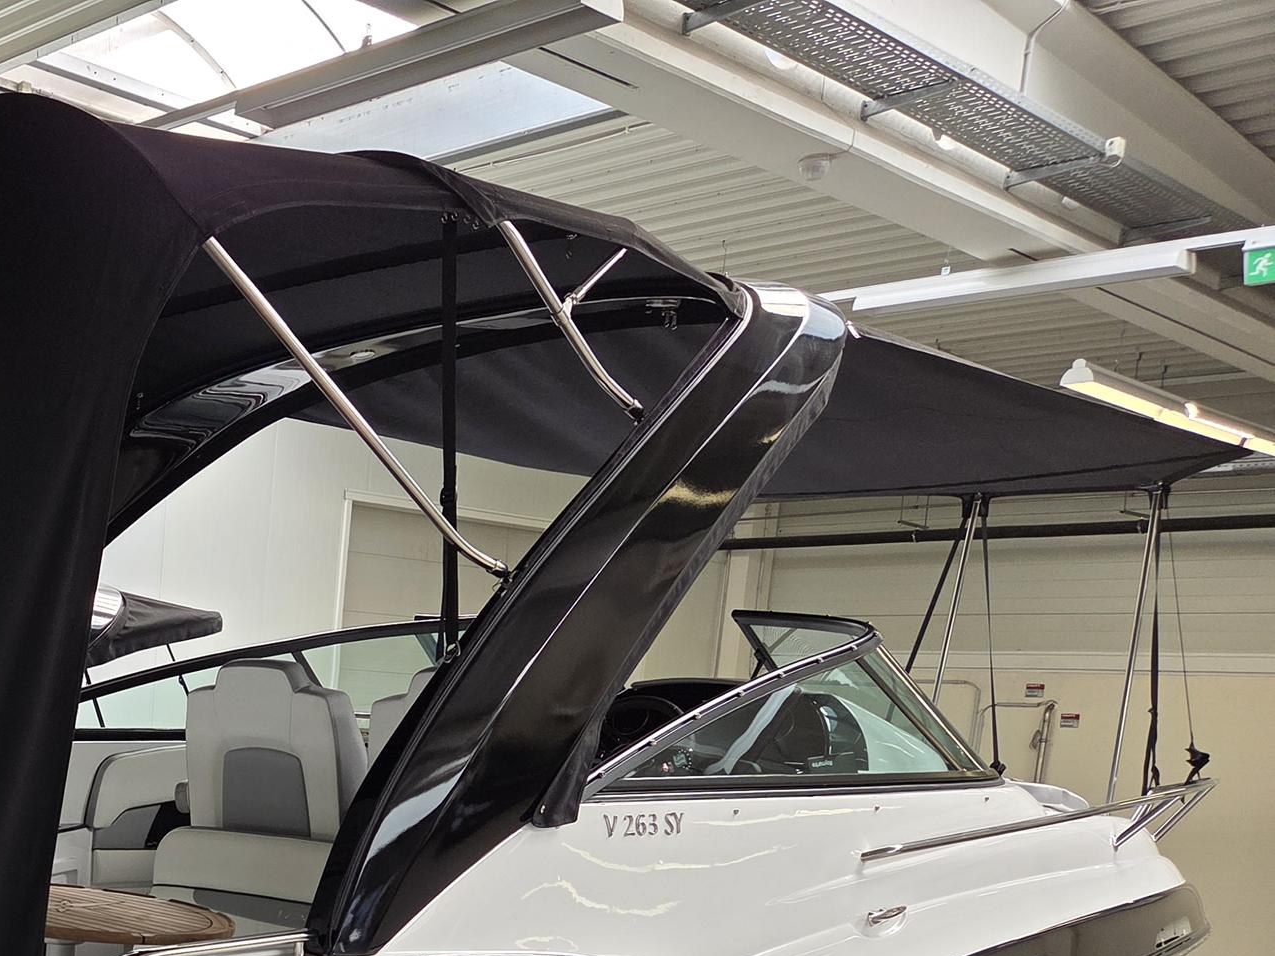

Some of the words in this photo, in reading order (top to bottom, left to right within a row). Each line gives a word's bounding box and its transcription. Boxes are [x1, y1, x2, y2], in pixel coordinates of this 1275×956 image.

[603, 814, 618, 838] V
[623, 813, 659, 837] 263
[664, 812, 685, 836] SY
